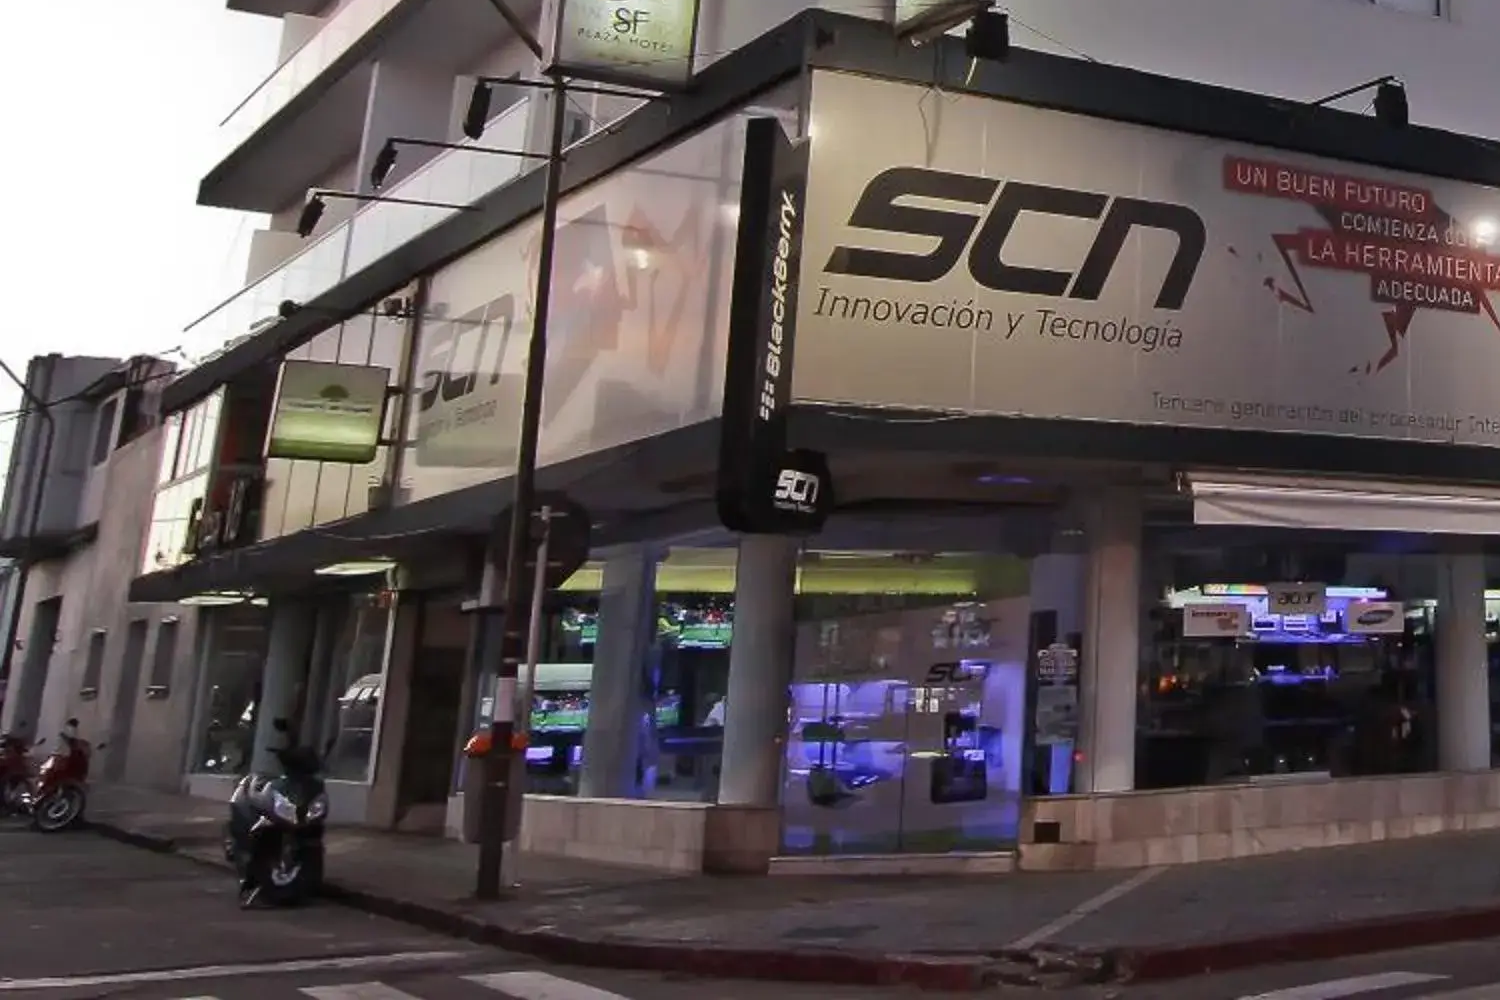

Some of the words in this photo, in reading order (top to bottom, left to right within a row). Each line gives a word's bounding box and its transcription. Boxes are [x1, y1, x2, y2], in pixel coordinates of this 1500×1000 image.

[1236, 163, 1268, 188] UN
[1278, 171, 1336, 200] BUEN
[1345, 180, 1426, 213] FUTURO
[1340, 212, 1439, 243] COMIENZA
[1308, 239, 1334, 262] LA
[1377, 279, 1474, 308] ADECUADA
[813, 287, 993, 332] Innovación
[1005, 310, 1025, 338] y
[1037, 309, 1184, 352] Tecnología
